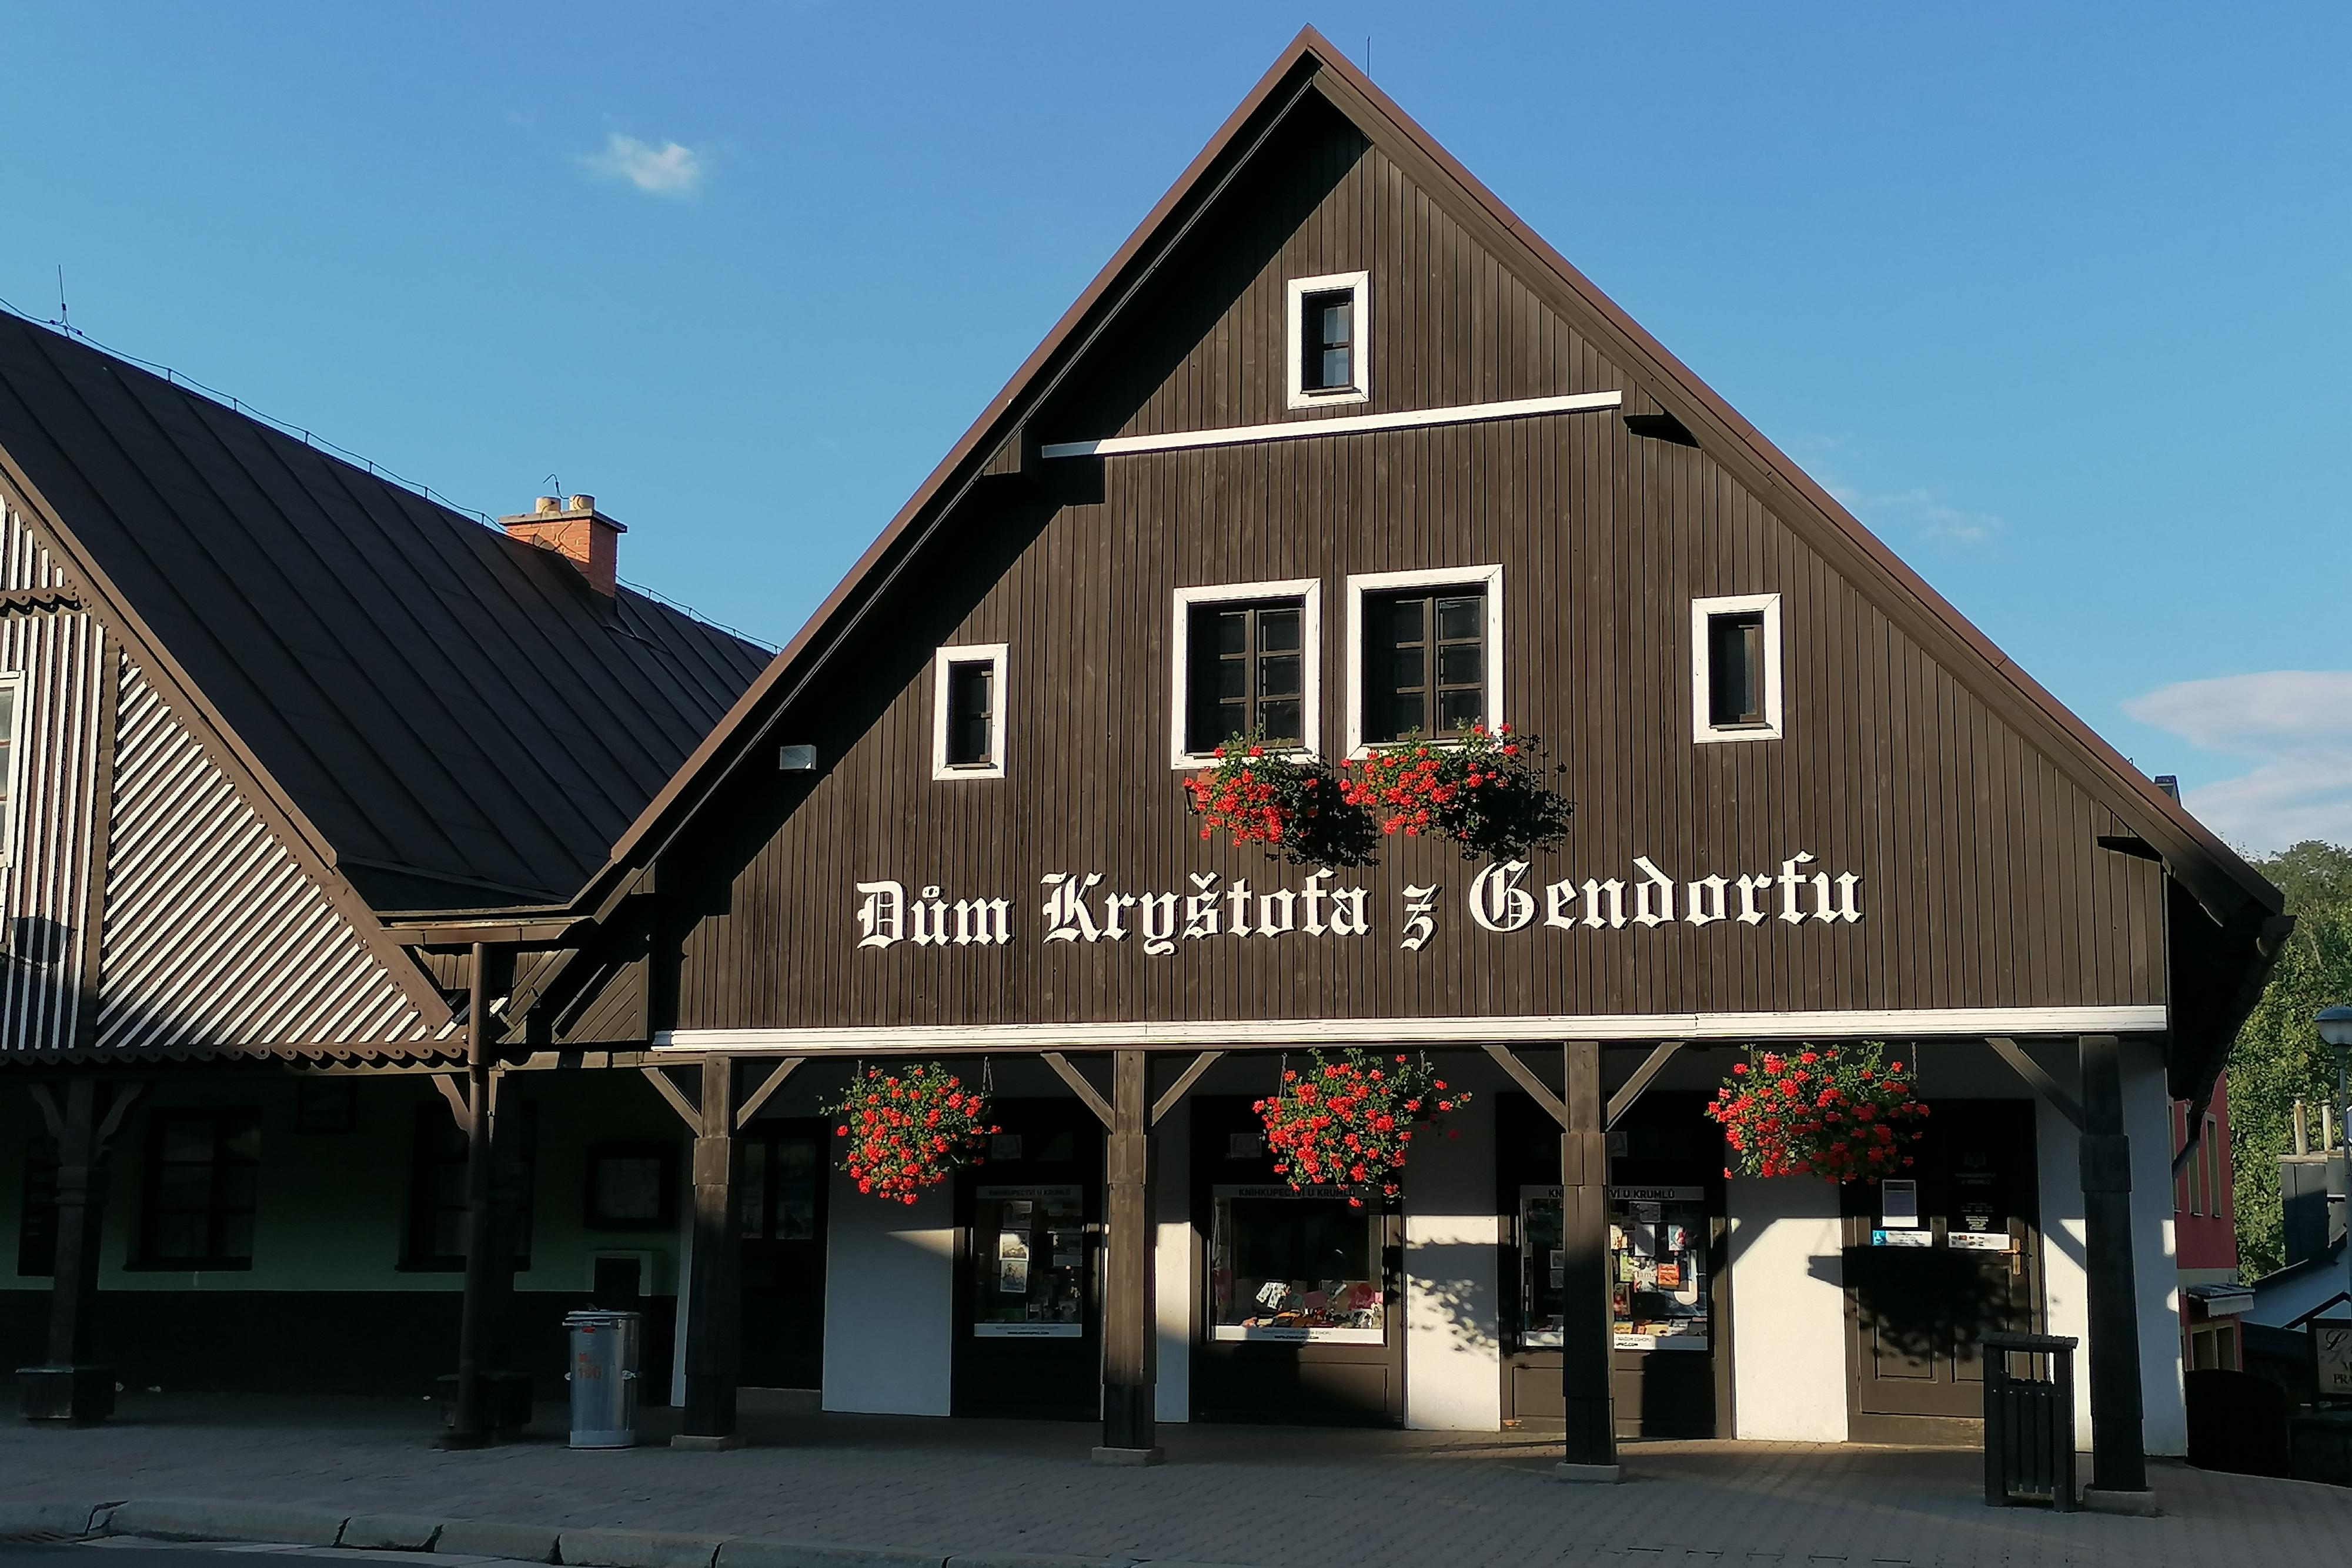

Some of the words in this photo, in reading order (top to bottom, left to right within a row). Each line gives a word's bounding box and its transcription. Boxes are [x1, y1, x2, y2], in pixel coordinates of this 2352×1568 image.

[856, 881, 1013, 949] Dům
[1040, 867, 1369, 955] Kryštofa
[1400, 884, 1438, 951] z
[1469, 851, 1864, 932] Gendorfu
[1308, 1188, 1314, 1196] U
[1317, 1186, 1355, 1197] KRUMLŮ
[1623, 1189, 1630, 1198] U
[1633, 1188, 1675, 1199] KRUMLŮ
